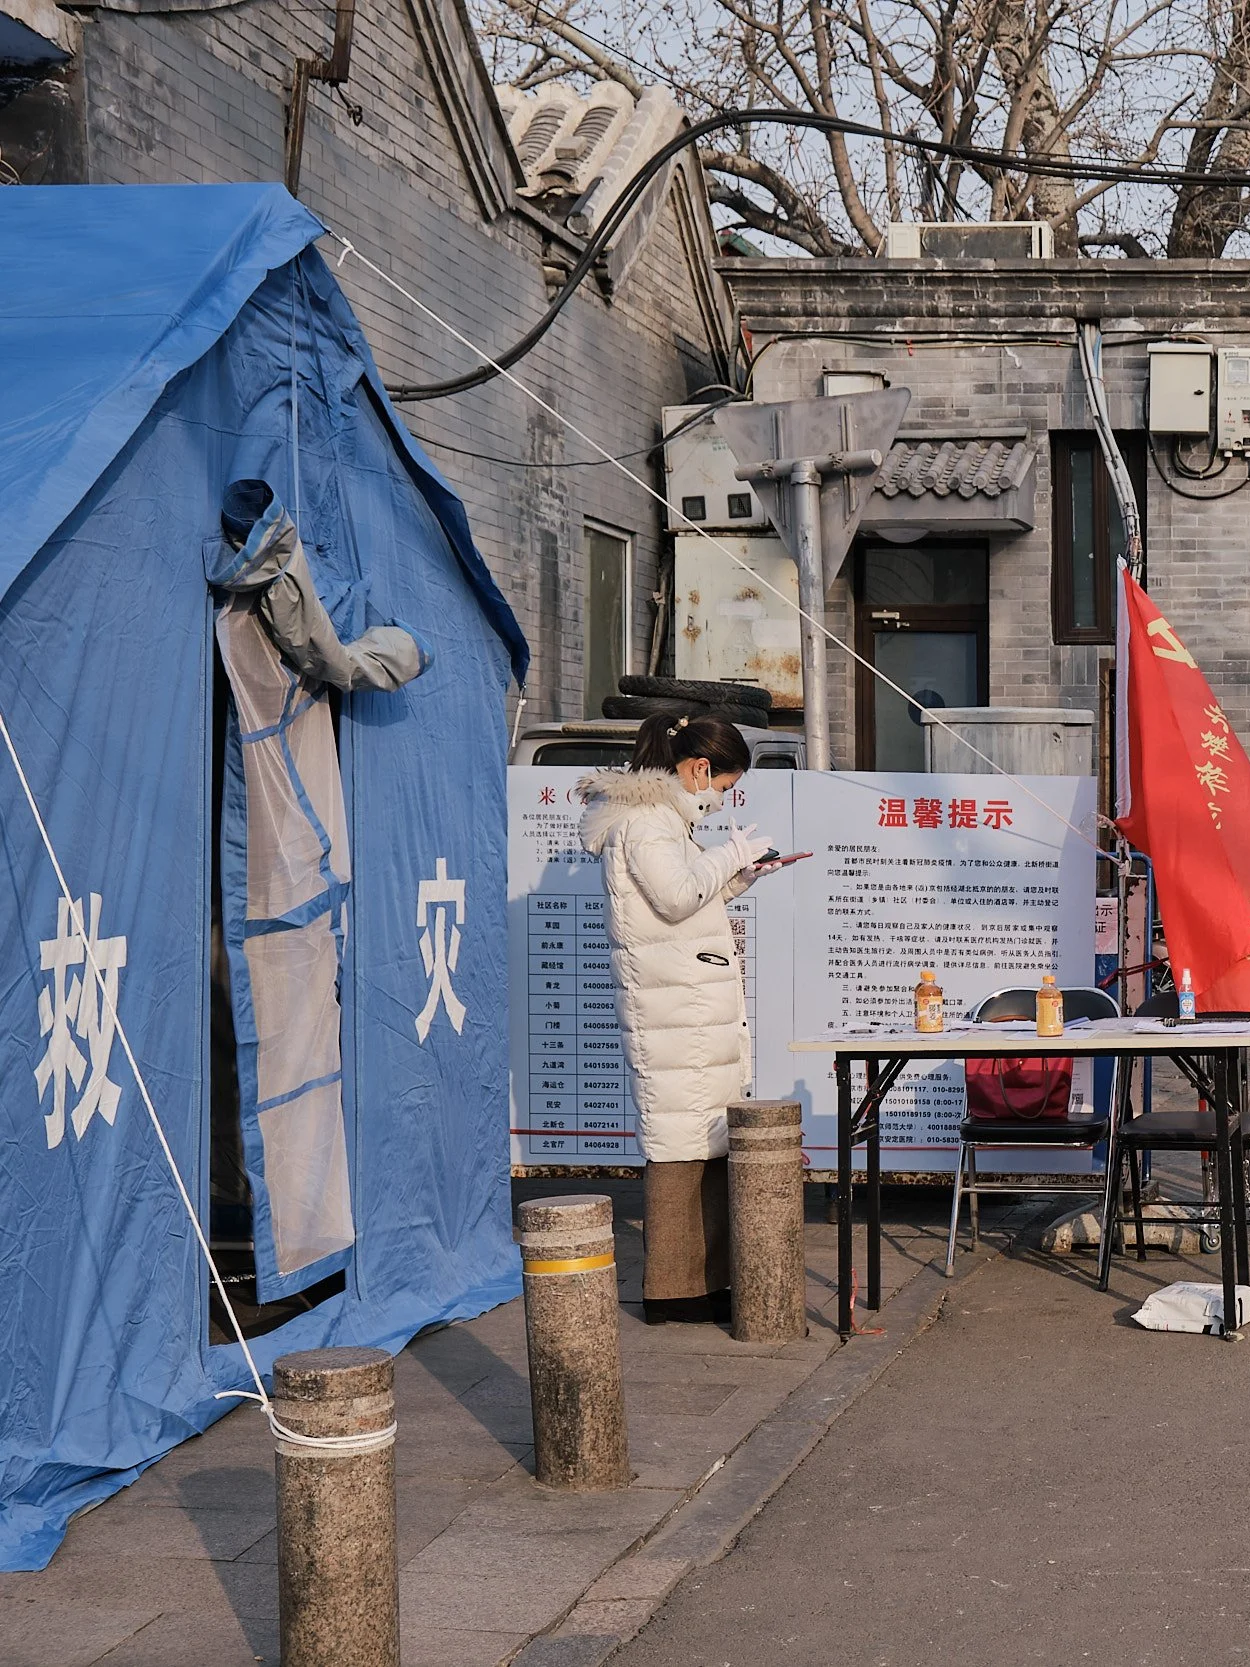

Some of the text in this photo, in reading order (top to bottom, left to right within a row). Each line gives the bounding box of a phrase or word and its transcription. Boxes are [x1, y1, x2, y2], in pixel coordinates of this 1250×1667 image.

[877, 797, 1014, 830] 温馨提示
[536, 902, 568, 910] 社区名称
[34, 857, 467, 1149] 救 灾
[541, 1041, 564, 1049] 十三条
[542, 1061, 565, 1069] 九道湾
[541, 1081, 565, 1089] 海运仓
[546, 1101, 561, 1109] 民安
[542, 1120, 619, 1129] 北新仓 84072141
[542, 1140, 565, 1149] 北官厅
